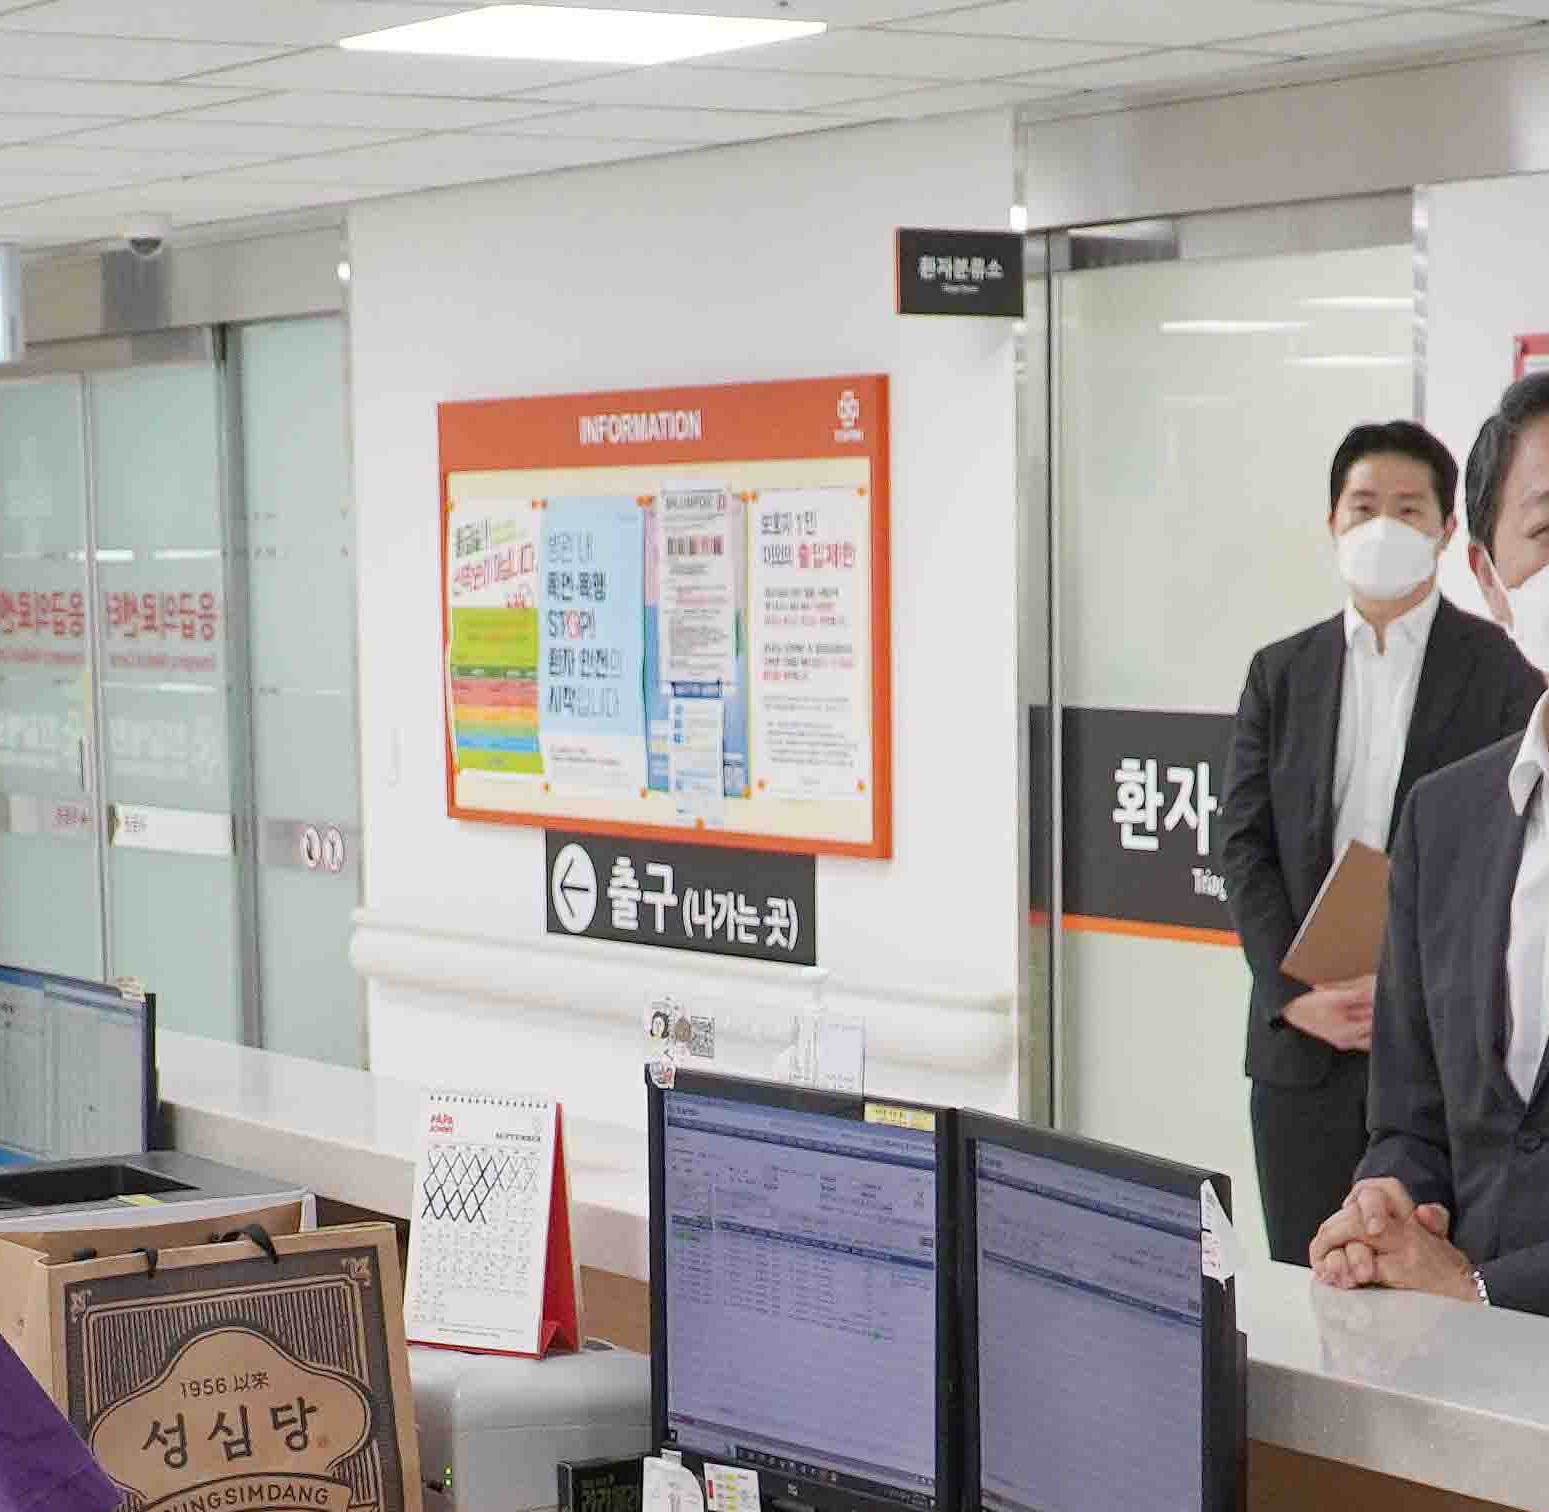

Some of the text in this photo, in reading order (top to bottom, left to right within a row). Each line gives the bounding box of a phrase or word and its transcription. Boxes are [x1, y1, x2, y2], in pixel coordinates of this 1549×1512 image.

[918, 255, 1004, 281] 환자분류소
[579, 407, 702, 446] INFORMATION
[1112, 757, 1223, 857] 환자
[607, 856, 800, 951] 출구 (나가는 곳)
[495, 1131, 541, 1144] SEPTEMBER
[180, 1371, 270, 1400] 1956 以來
[141, 1396, 318, 1469] 성심당
